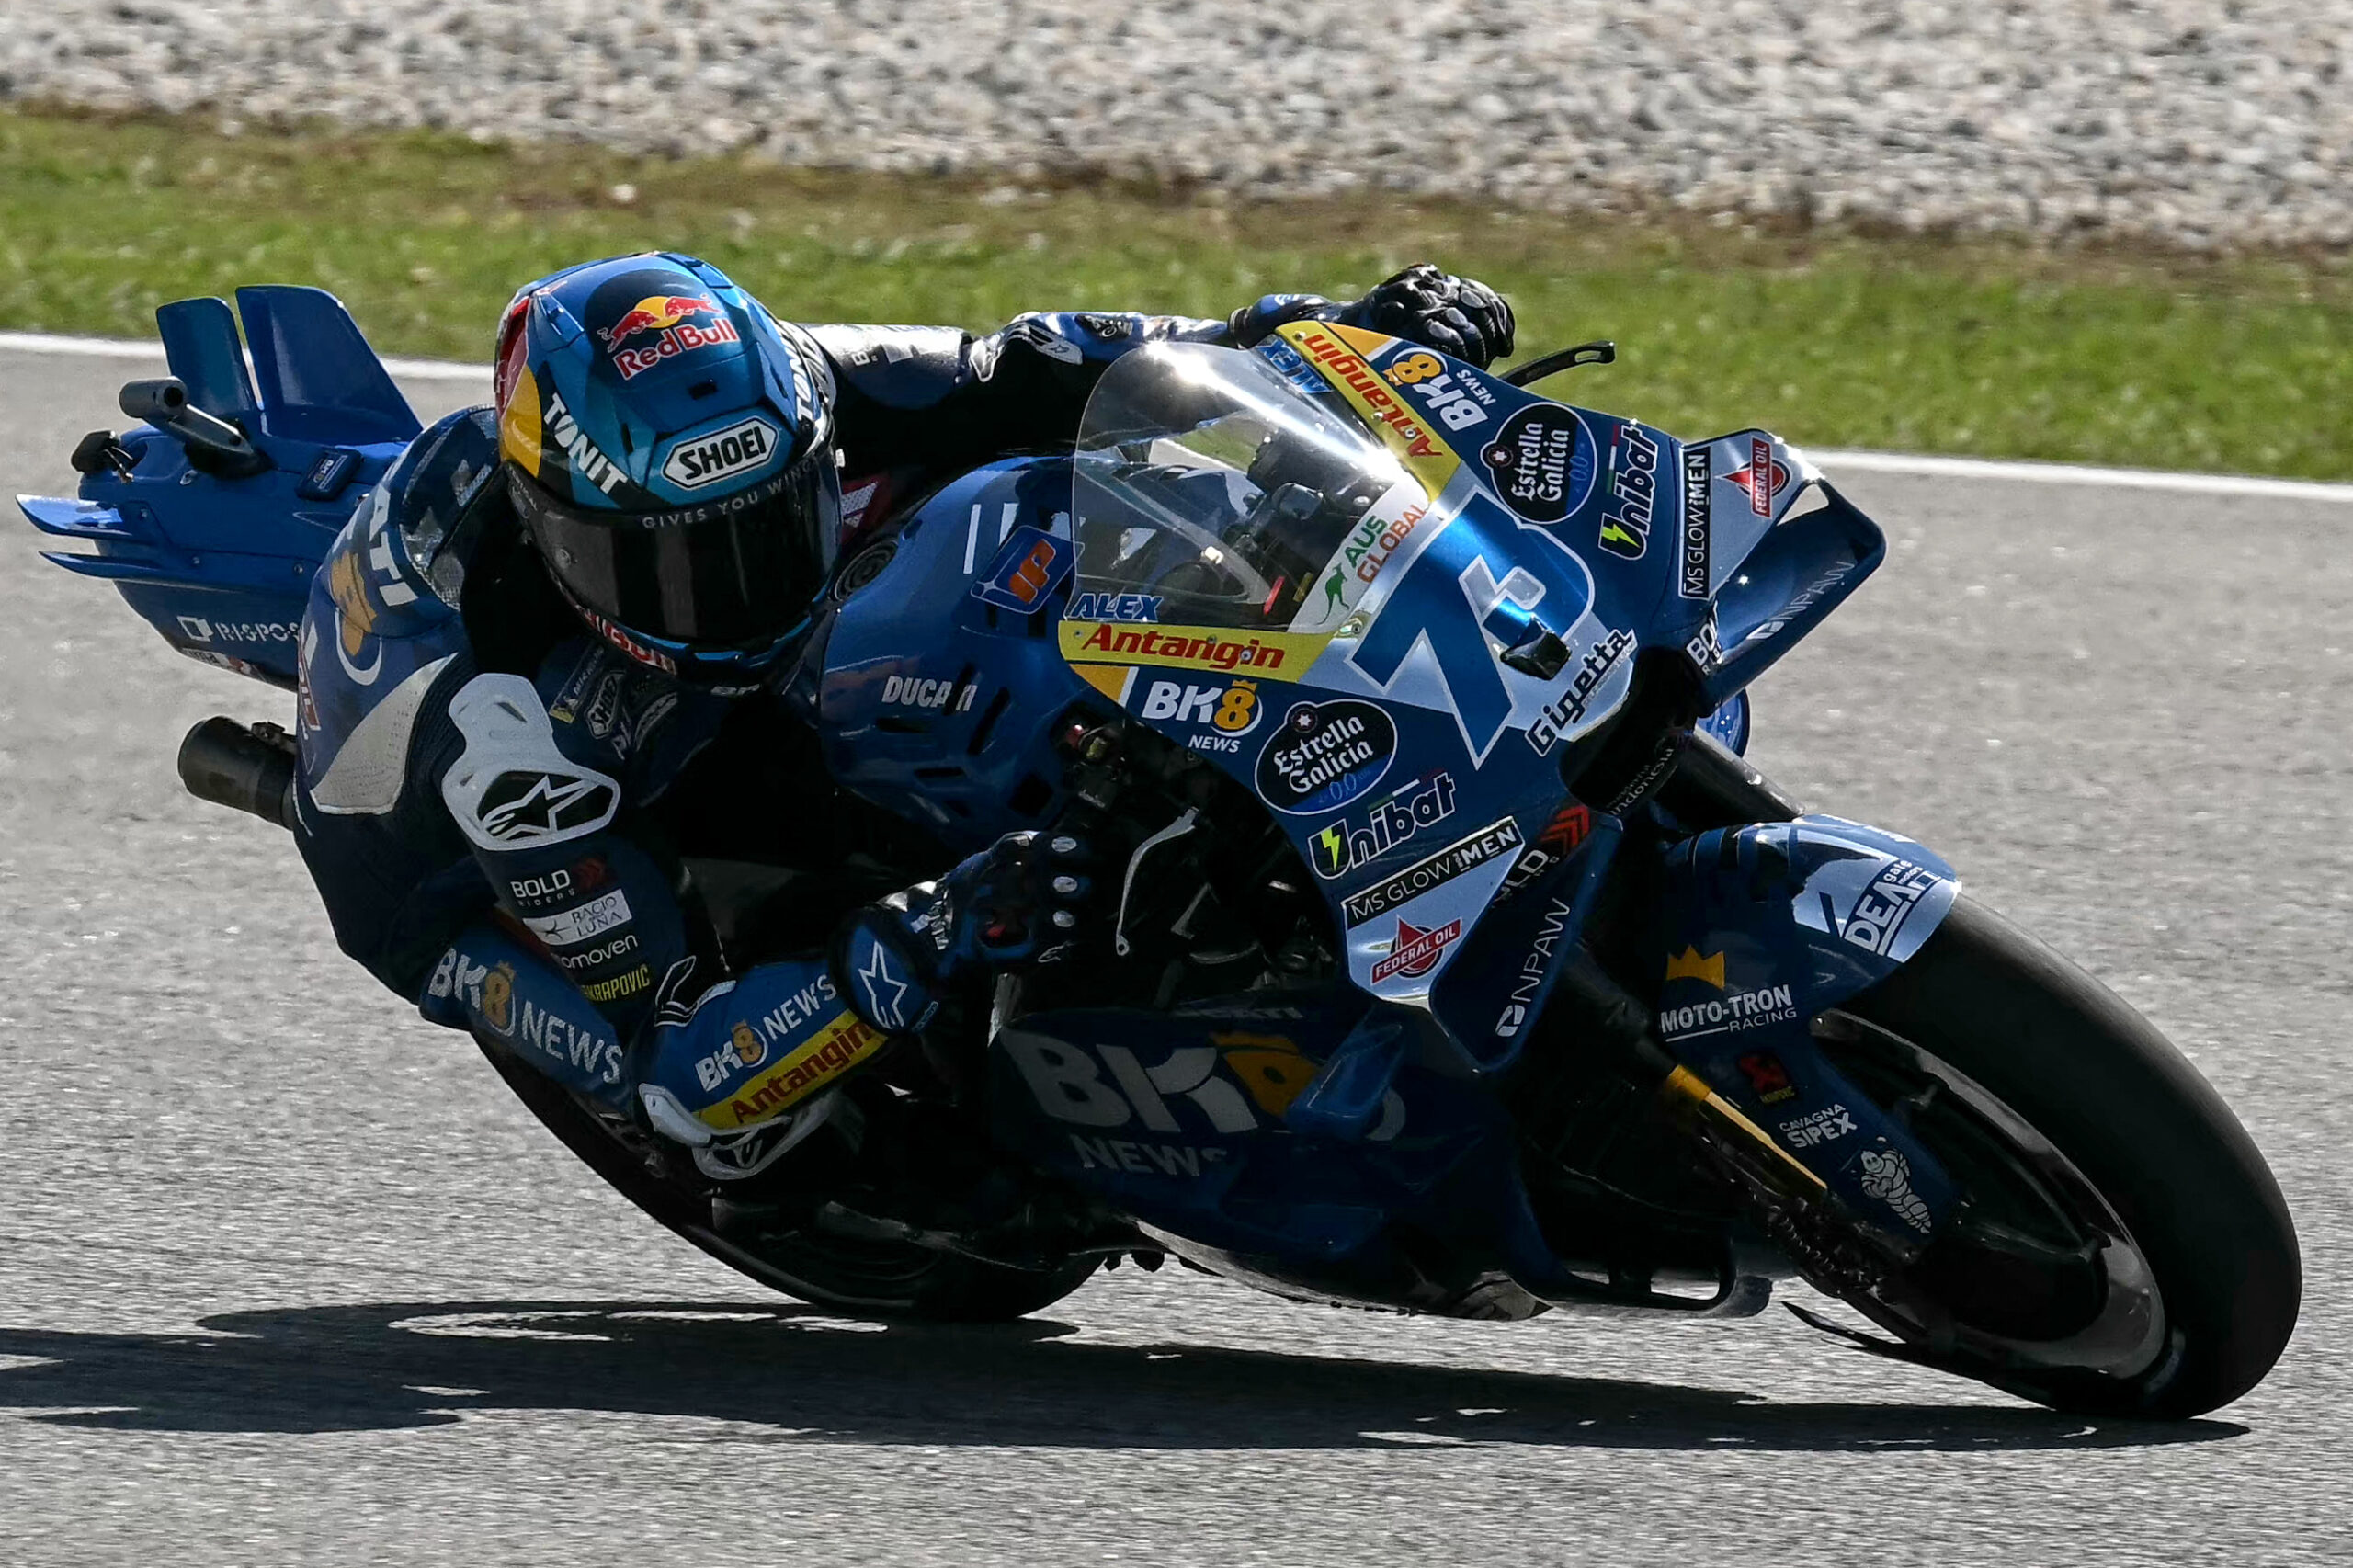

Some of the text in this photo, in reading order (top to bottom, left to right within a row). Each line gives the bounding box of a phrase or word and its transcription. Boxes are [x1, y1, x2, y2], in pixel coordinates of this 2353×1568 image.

[613, 319, 739, 380] Red Bull
[1255, 336, 1335, 394] ALEX
[1302, 334, 1444, 459] Antangin
[1383, 350, 1489, 432] BK8
[1456, 369, 1496, 406] NEWS
[677, 426, 767, 481] SHOEI
[1511, 422, 1544, 502] Estrella
[1536, 429, 1570, 502] Galicia
[1688, 454, 1709, 496] MEN
[1755, 445, 1768, 514] FEDERAL OIL
[642, 508, 707, 528] GIVES
[717, 491, 758, 515] YOU
[1598, 424, 1658, 561] Unibat
[1343, 515, 1389, 568] AUS
[1356, 505, 1427, 584] GLOBAL
[1687, 506, 1706, 565] GLOW
[1070, 593, 1165, 622] ALEX
[1684, 567, 1705, 595] MS
[1082, 625, 1285, 670] Antangin
[1142, 679, 1263, 736] BK8
[1526, 628, 1636, 756] Gigetta
[1188, 735, 1241, 753] NEWS
[1274, 716, 1366, 776] Estrella
[1289, 740, 1374, 793] Galicia
[1307, 773, 1456, 880] Unibat
[510, 869, 572, 898] BOLD
[1349, 892, 1386, 920] MS
[1386, 857, 1452, 903] GLOW
[1460, 825, 1518, 866] MEN
[577, 912, 623, 937] LUNA
[1374, 925, 1457, 979] FEDERAL OIL
[695, 1020, 768, 1093] BK8
[762, 972, 838, 1041] NEWS
[1660, 983, 1793, 1033] MOTO-TRON
[1728, 1006, 1798, 1033] RACING
[522, 1000, 623, 1084] NEWS
[731, 1019, 873, 1124] Antangin
[1779, 1103, 1847, 1131] CAVAGNA
[1787, 1111, 1858, 1148] SIPEX
